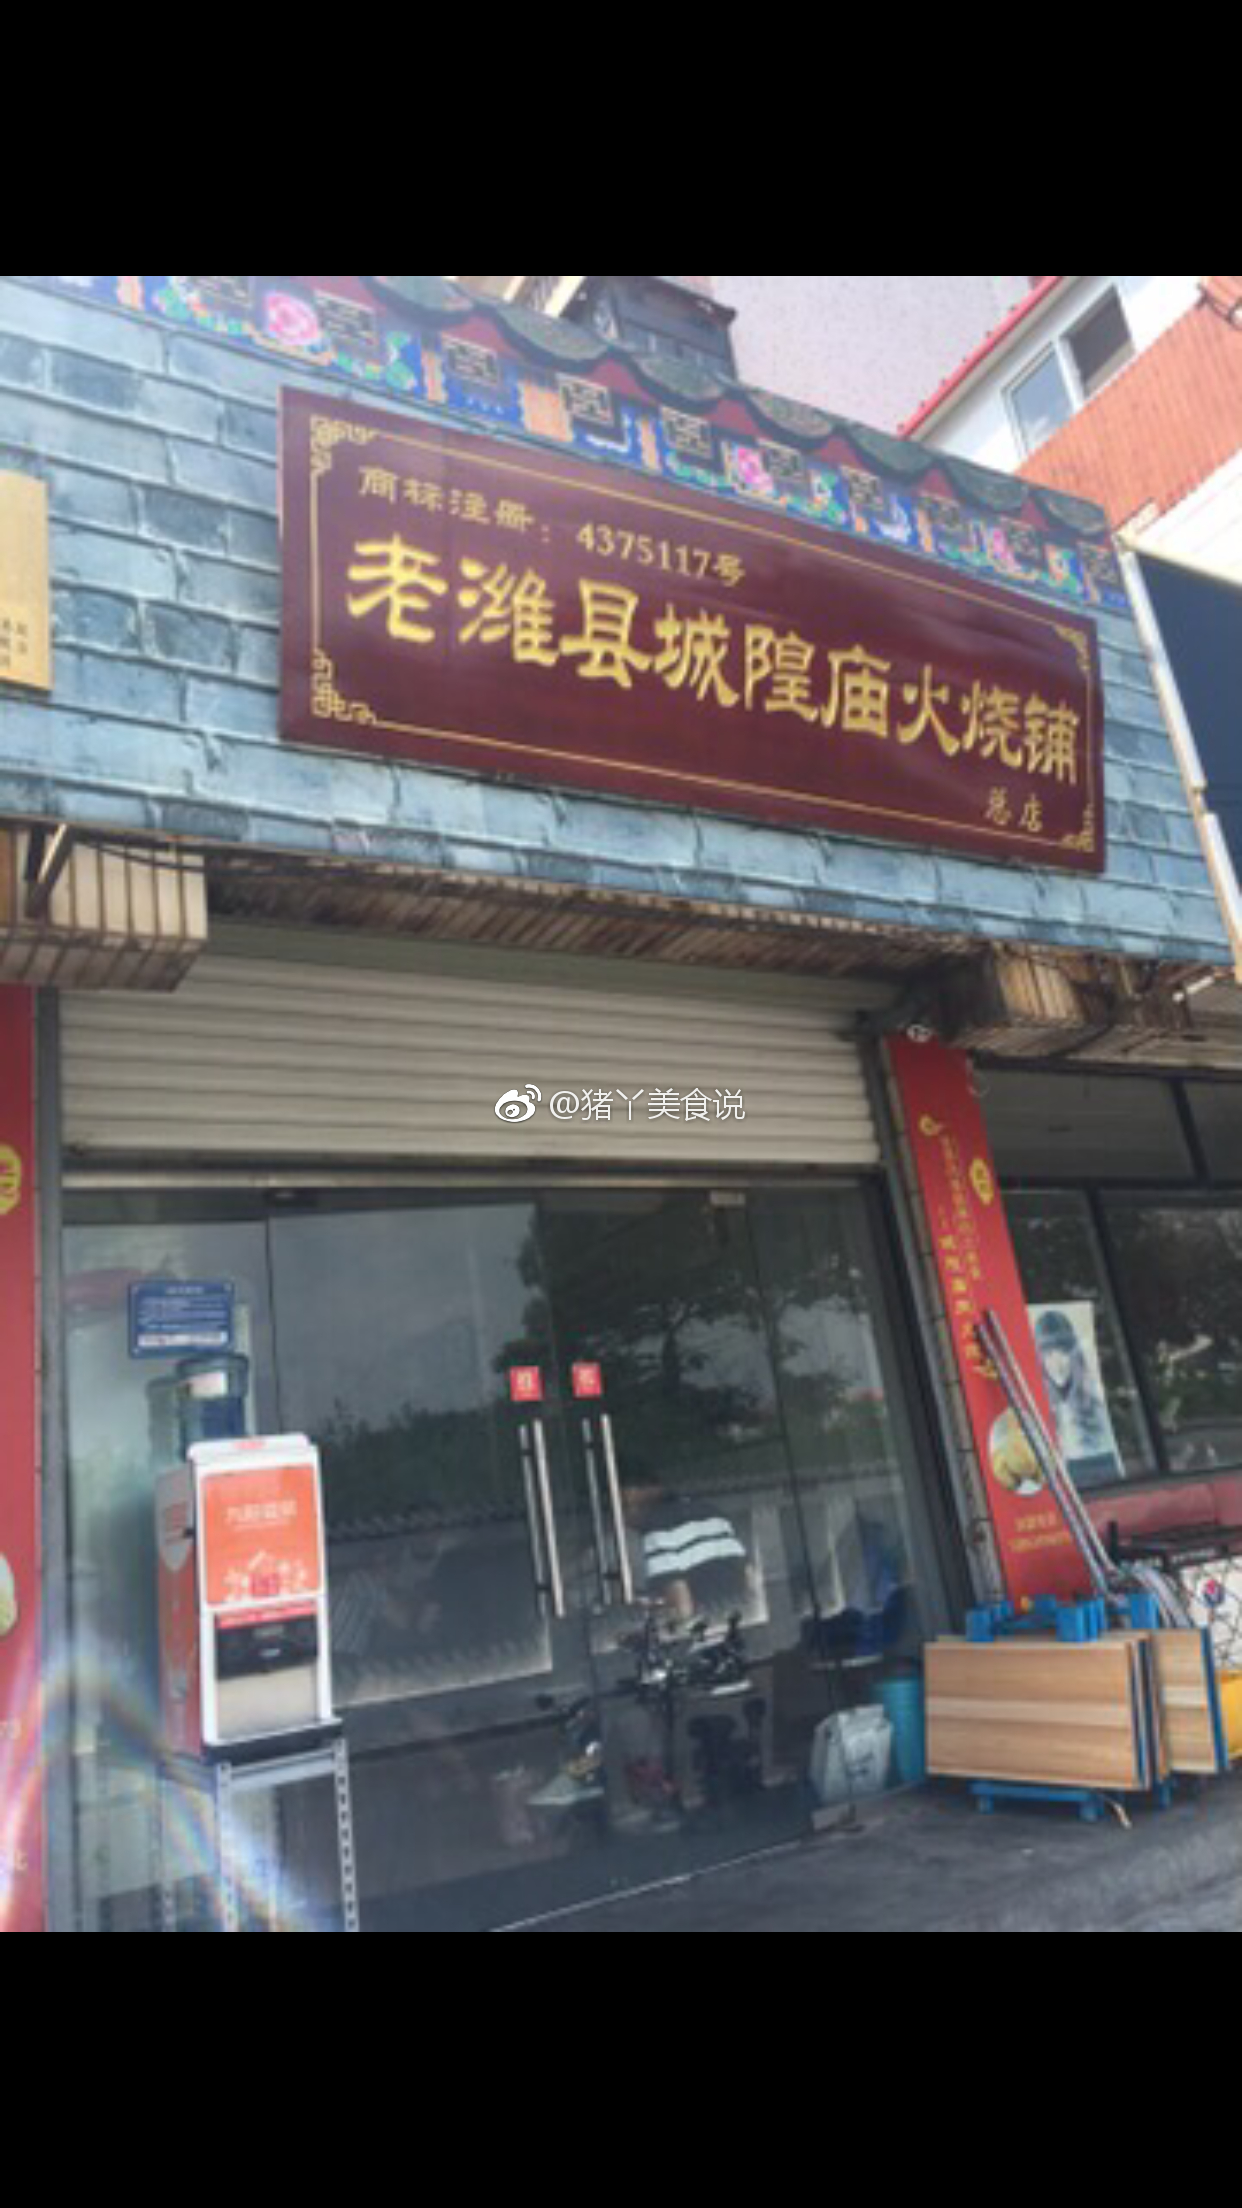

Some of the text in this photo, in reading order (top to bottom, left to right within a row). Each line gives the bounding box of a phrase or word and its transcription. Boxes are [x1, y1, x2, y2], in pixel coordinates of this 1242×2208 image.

[346, 533, 1079, 784] 老潍县城隍庙火烧铺
